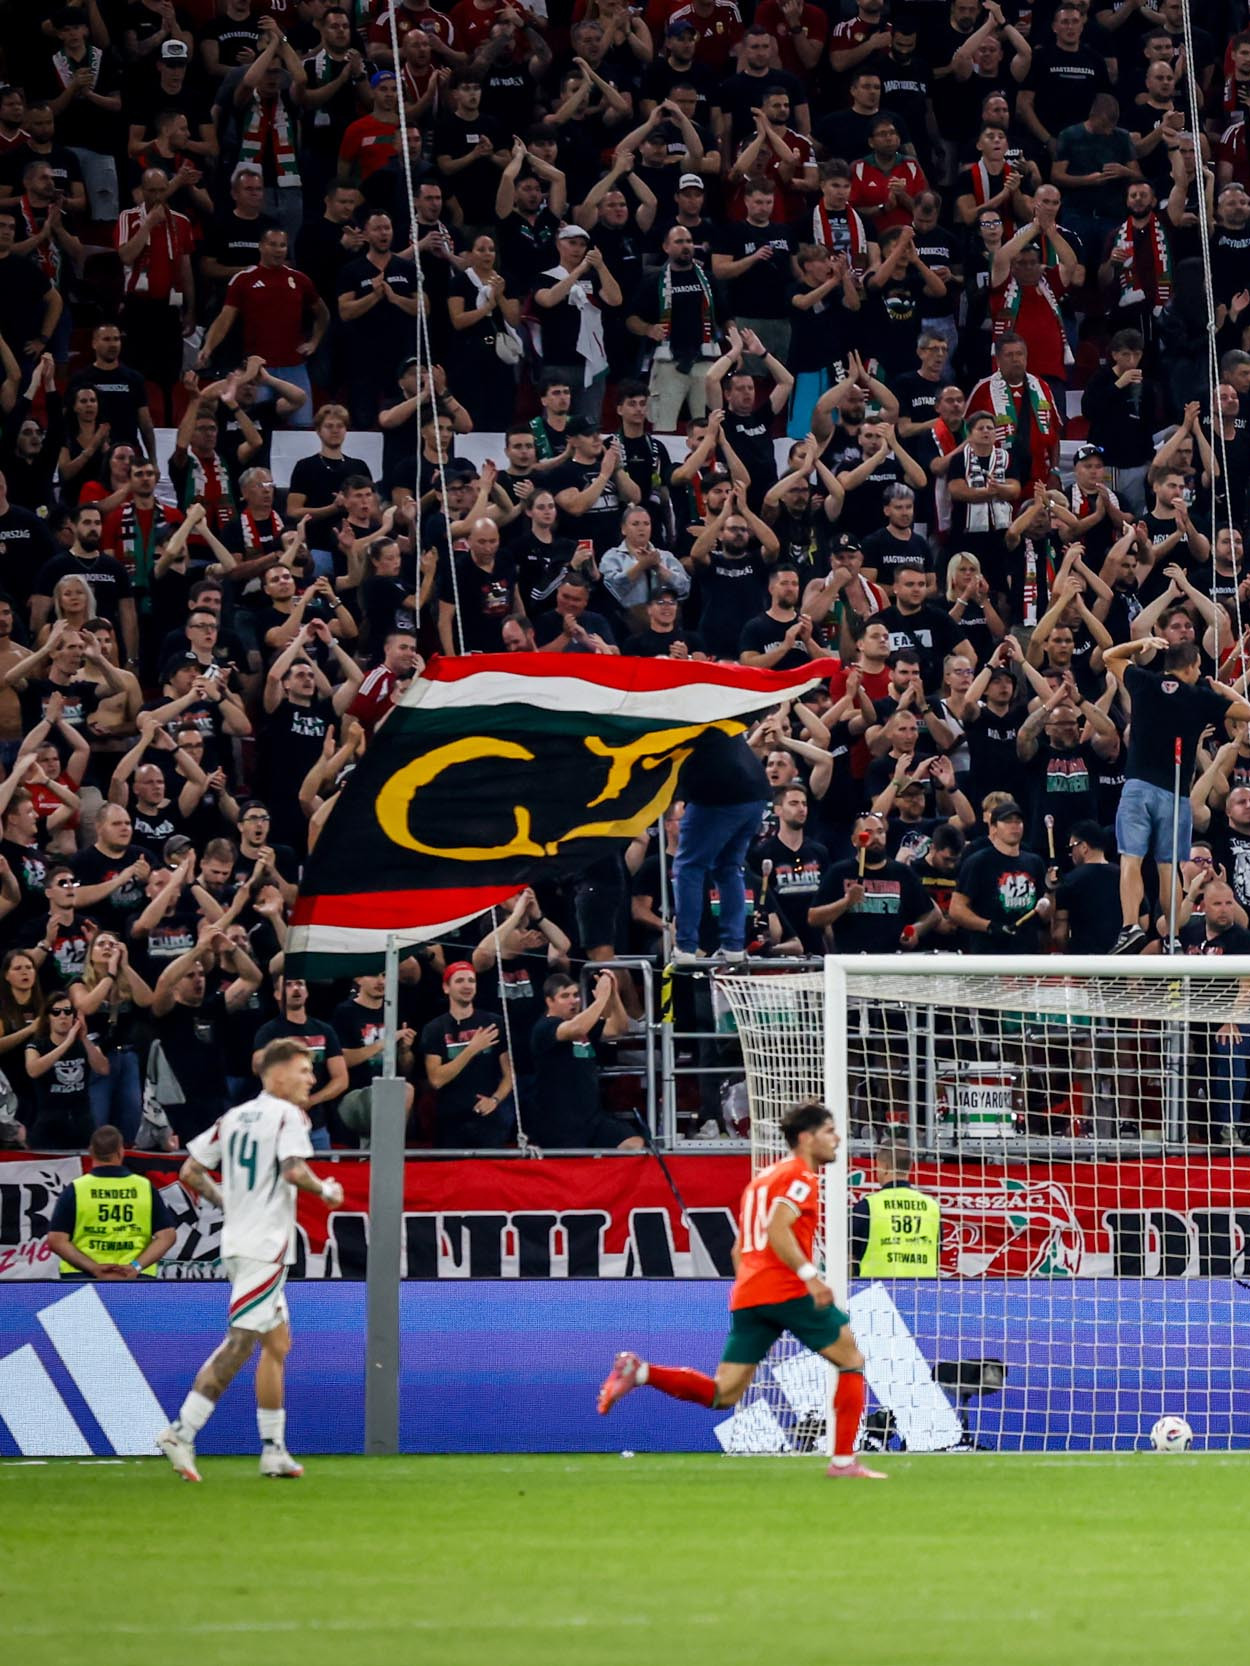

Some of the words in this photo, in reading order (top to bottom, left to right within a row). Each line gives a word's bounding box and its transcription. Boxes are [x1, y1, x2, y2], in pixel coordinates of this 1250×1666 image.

[227, 1130, 259, 1193] 14
[97, 1203, 134, 1223] 546
[890, 1214, 922, 1234] 587
